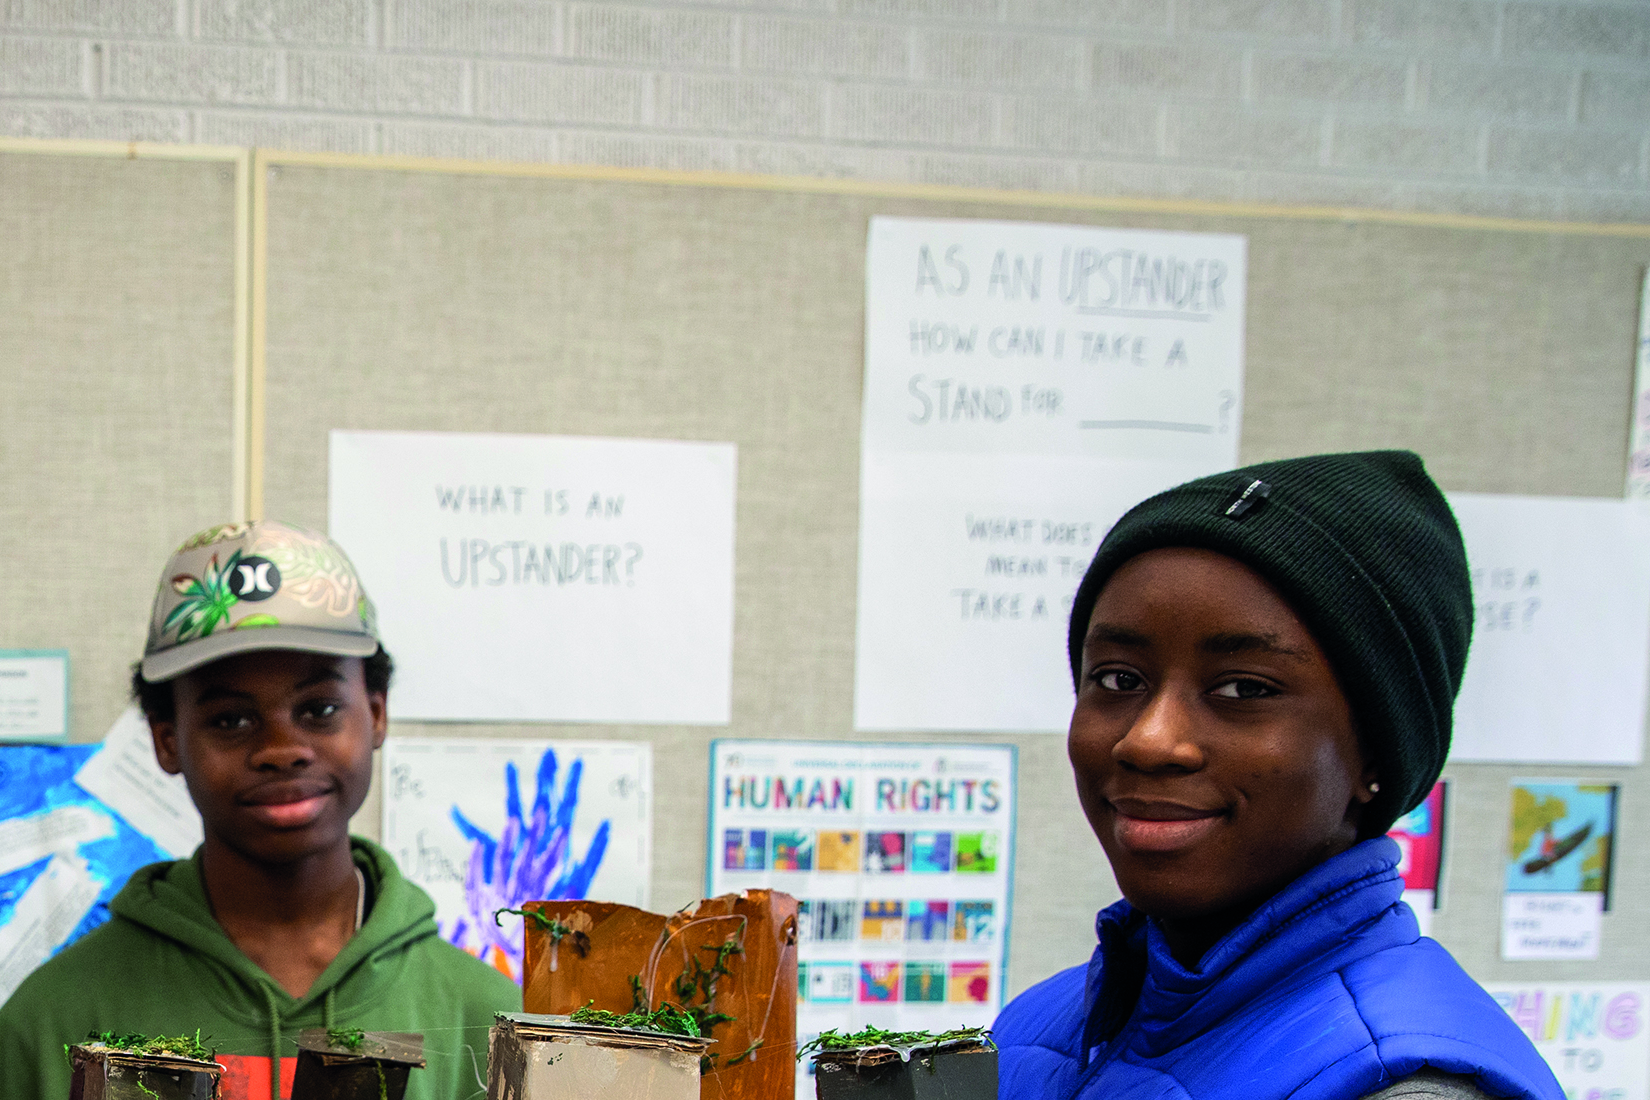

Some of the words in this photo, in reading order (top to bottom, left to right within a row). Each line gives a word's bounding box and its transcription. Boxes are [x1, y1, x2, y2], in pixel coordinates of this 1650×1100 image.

[915, 243, 970, 297] AS
[987, 248, 1044, 301] AN
[1059, 246, 1228, 311] UPSTANDER
[908, 319, 978, 356] HOW
[987, 324, 1045, 359] CAN
[1054, 328, 1065, 361] I
[1078, 330, 1148, 367] TAKE
[1165, 337, 1189, 369] A
[908, 374, 1012, 426] STAND
[434, 484, 528, 515] WHAT
[543, 488, 570, 515] IS
[585, 491, 625, 518] AN
[965, 513, 1032, 543] WHAT
[439, 537, 644, 588] UPSTANDER?
[950, 588, 1021, 622] TAKE
[723, 775, 854, 810] HUMAN
[877, 777, 1001, 813] RIGHTS
[1561, 1048, 1603, 1074] TO
